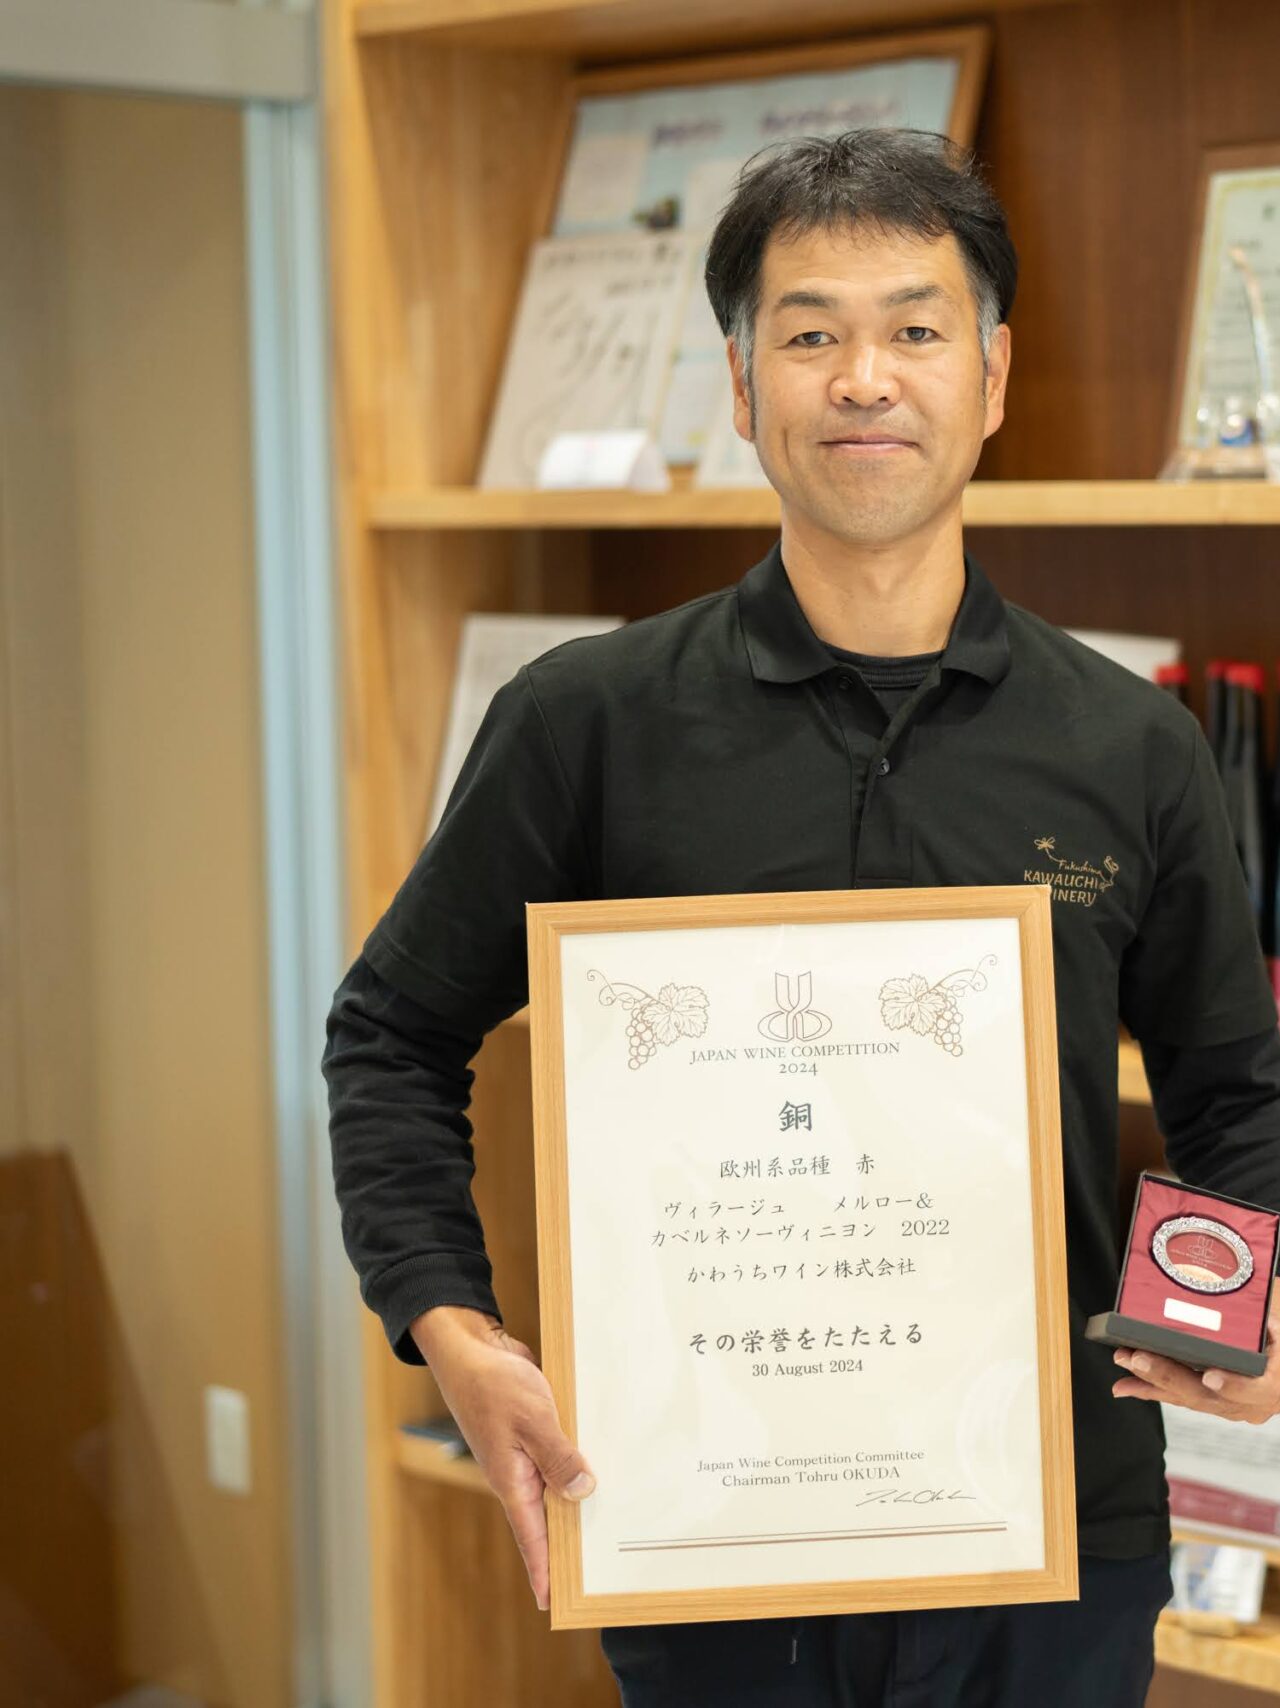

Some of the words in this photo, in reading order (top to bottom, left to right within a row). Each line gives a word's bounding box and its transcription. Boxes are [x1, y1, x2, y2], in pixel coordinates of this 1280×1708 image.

[1058, 860, 1101, 875] Fukushima
[1023, 869, 1098, 890] KAWAUCHI
[1051, 889, 1097, 907] INERY
[689, 1048, 737, 1064] JAPAN
[744, 1046, 786, 1059] WINE
[791, 1041, 900, 1058] COMPETITION
[779, 1062, 818, 1076] 2024
[778, 1100, 813, 1132] 銅
[720, 1155, 831, 1179] 欧州系品種
[855, 1153, 875, 1175] 赤
[664, 1198, 785, 1220] ヴィラージュ
[834, 1192, 935, 1212] メルロー&
[651, 1223, 877, 1248] カベルネソーヴィニヨン
[901, 1218, 950, 1237] 2022
[687, 1257, 917, 1284] かわうちワイン株式会社
[689, 1323, 922, 1355] その栄誉をたたえる
[752, 1363, 769, 1377] 30
[774, 1362, 824, 1377] August
[829, 1359, 863, 1373] 2024
[697, 1459, 734, 1472] Japan
[738, 1457, 771, 1469] Wine
[774, 1454, 852, 1469] Competition
[855, 1449, 925, 1463] Committee
[722, 1473, 791, 1487] Chairman
[797, 1470, 839, 1484] Tohru
[842, 1466, 901, 1481] OKUDA
